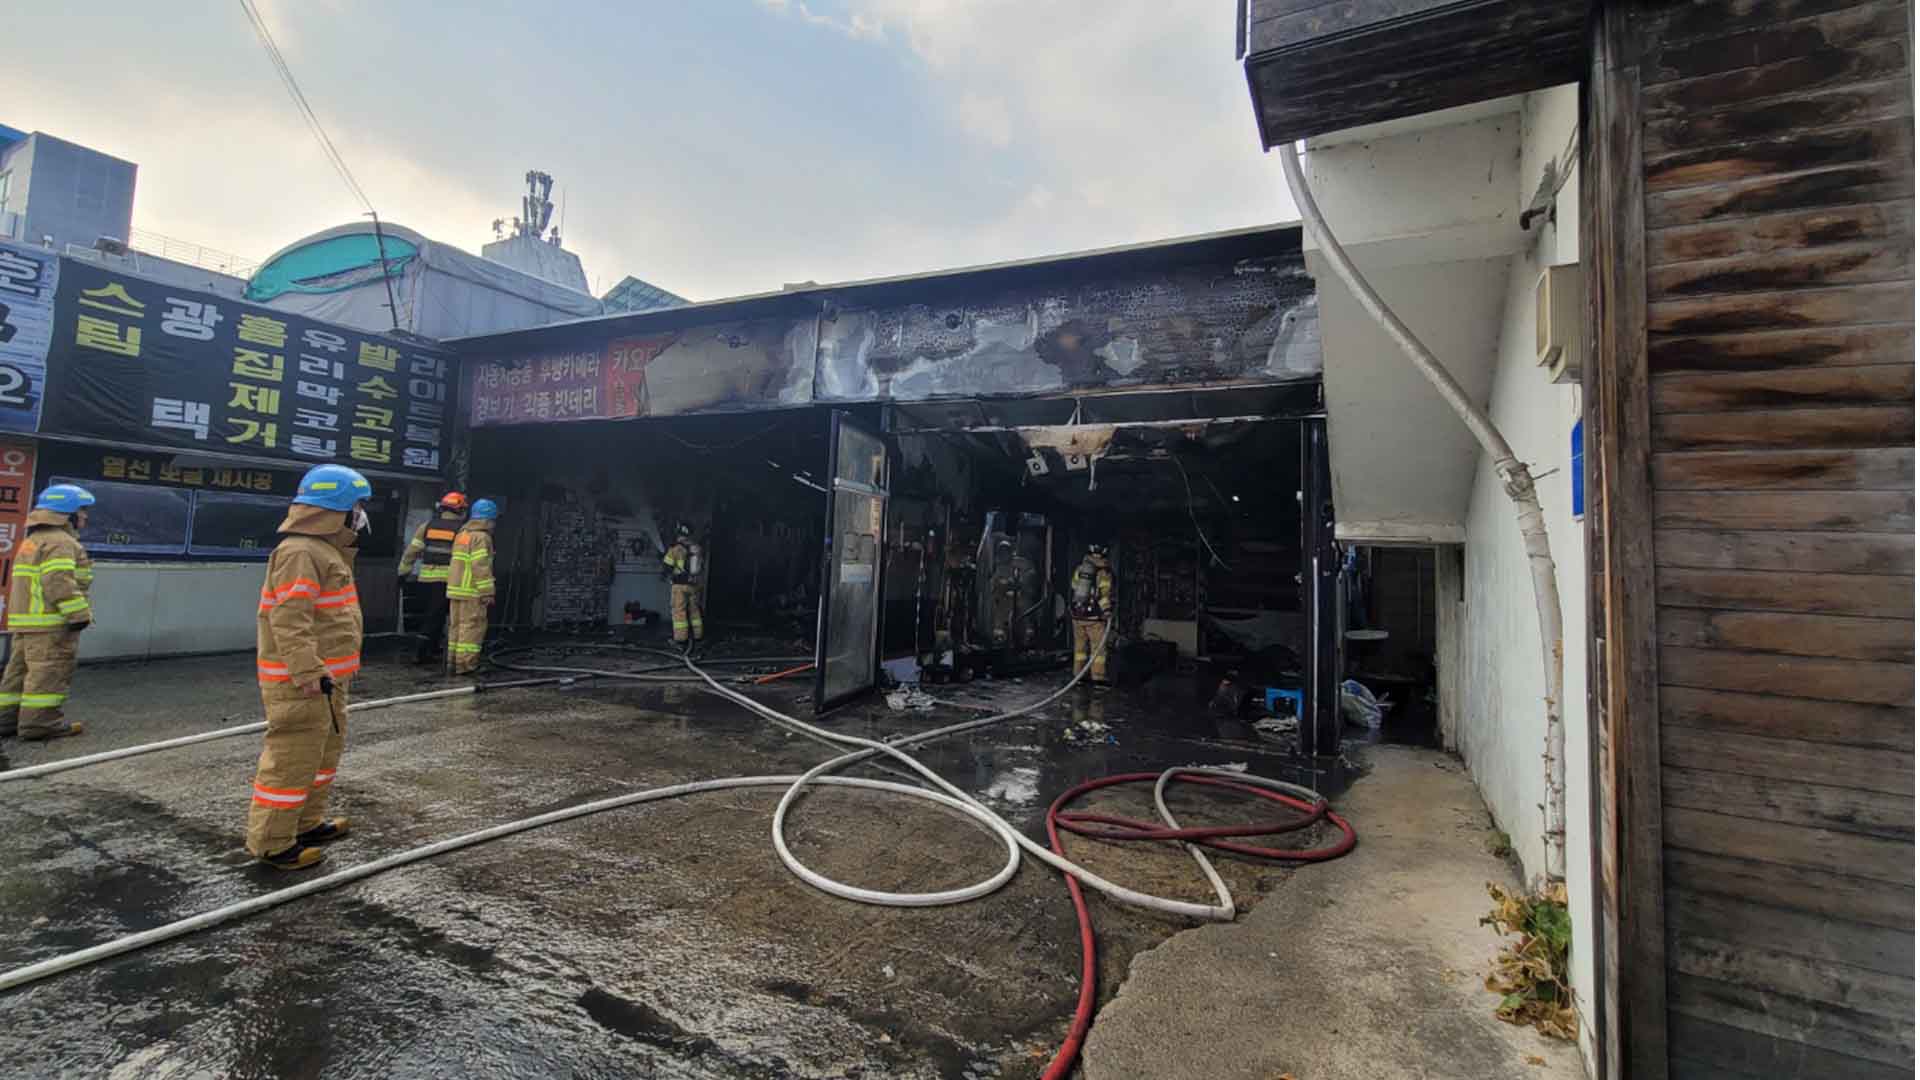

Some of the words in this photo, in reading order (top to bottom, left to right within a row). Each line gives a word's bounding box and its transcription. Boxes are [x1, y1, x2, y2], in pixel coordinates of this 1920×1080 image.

[76, 282, 146, 357] 스팀
[226, 313, 288, 448] 흠집제거
[290, 329, 347, 458] 유리막코팅
[350, 341, 401, 464] 발수코팅
